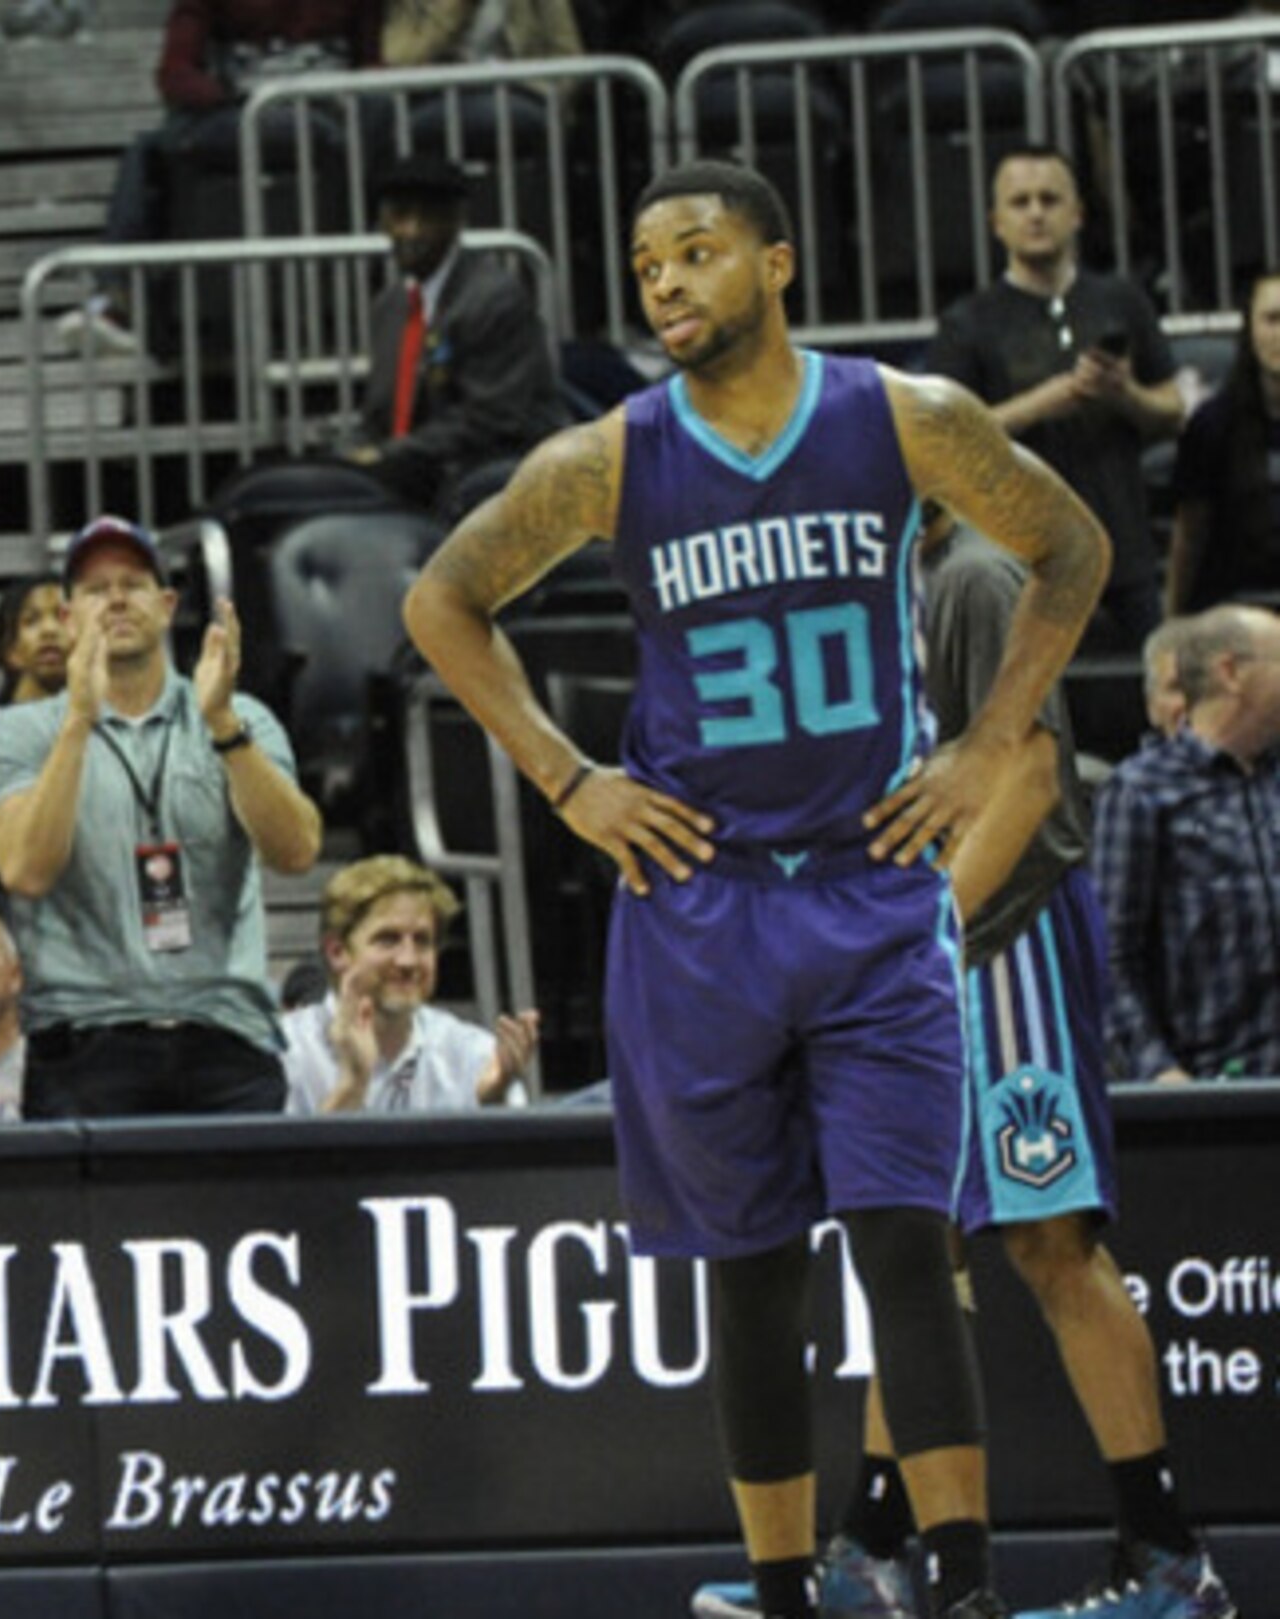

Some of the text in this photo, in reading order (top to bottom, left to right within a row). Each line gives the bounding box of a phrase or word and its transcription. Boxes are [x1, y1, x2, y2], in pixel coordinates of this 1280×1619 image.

[651, 510, 888, 612] HORNETS
[686, 601, 882, 748] 30
[359, 1194, 876, 1396] PIGUT
[1163, 1337, 1261, 1395] the
[105, 1450, 397, 1530] Brassus
